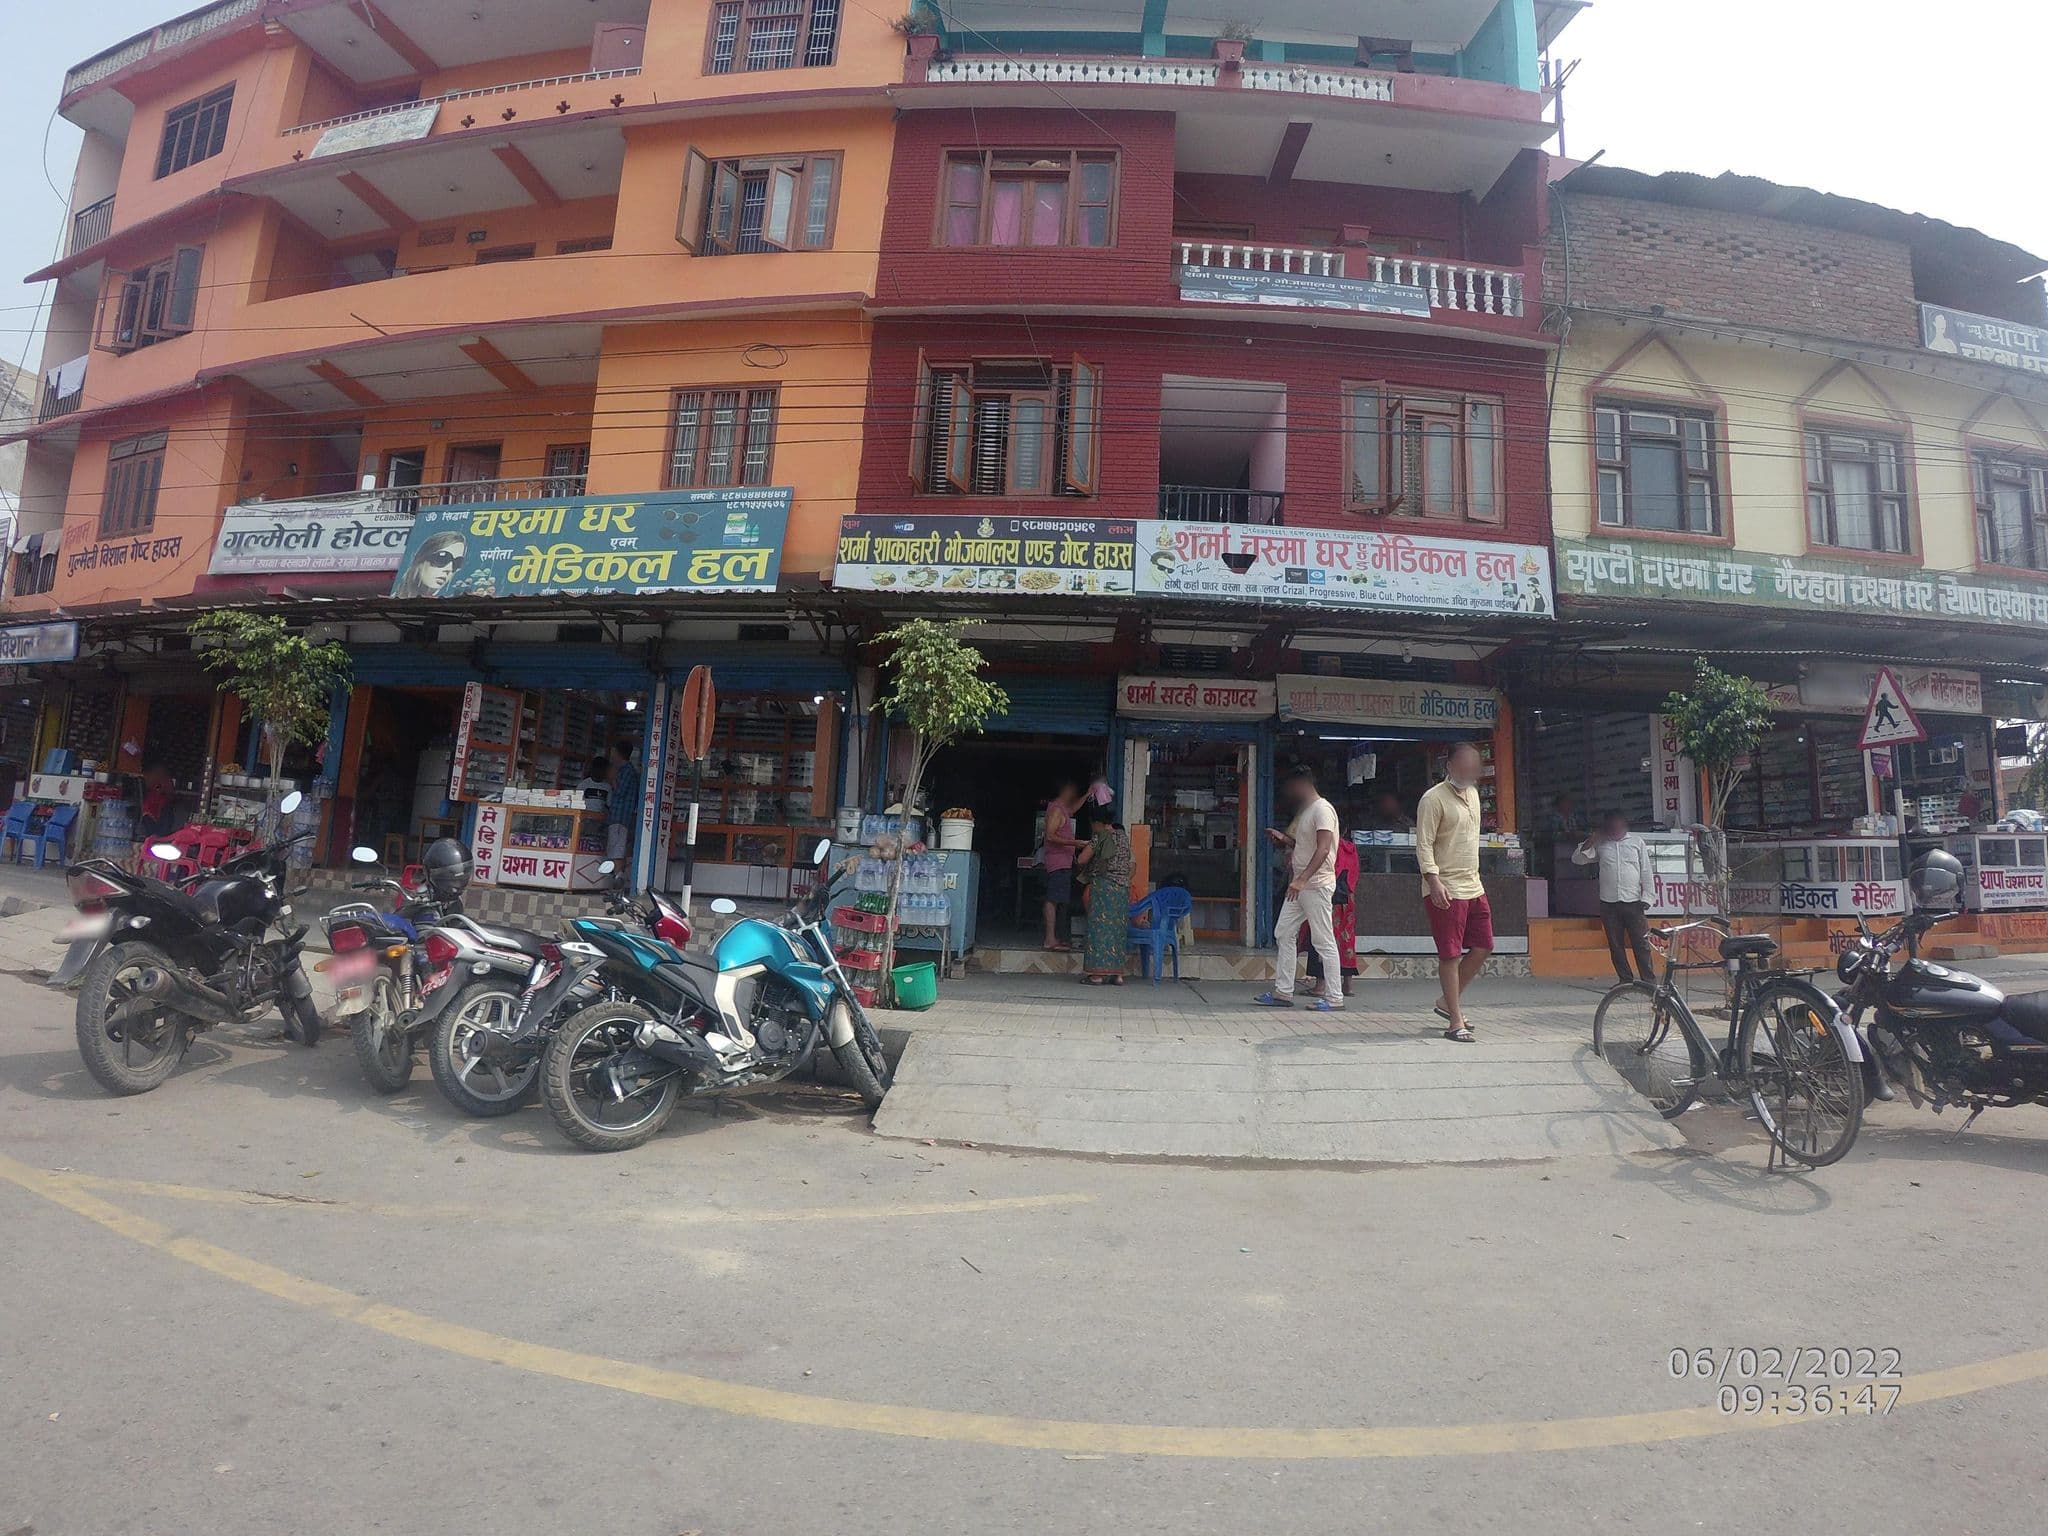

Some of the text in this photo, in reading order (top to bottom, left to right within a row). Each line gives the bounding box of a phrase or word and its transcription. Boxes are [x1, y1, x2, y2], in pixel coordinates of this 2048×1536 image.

[579, 503, 645, 534] घर
[331, 521, 412, 549] होटल
[839, 530, 1134, 571] शर्मा शाकाहारी भोजनालय एण्ड गेष्ट हाउस
[99, 543, 130, 569] विशाल
[151, 536, 183, 563] हाउस
[507, 543, 677, 585] मेडिकल
[687, 547, 774, 584] हल
[1174, 526, 1232, 563] शर्मा
[1315, 539, 1353, 571] घर
[1372, 533, 1467, 578] मेडिकल
[1475, 551, 1517, 582] हल
[1309, 587, 1358, 601] Progressive,
[1359, 589, 1378, 600] Blue
[1378, 591, 1395, 602] Cut,
[1396, 592, 1450, 606] Photochromic
[1642, 555, 1710, 592] चश्मा
[1716, 562, 1756, 594] घर
[1904, 580, 1933, 612] घर
[1126, 680, 1258, 709] शर्मा सटही काउण्टर
[1420, 688, 1470, 718] मेडिकल
[476, 806, 570, 880] मेडिकल चश्मा घर
[1980, 870, 2005, 890] थापा
[2005, 875, 2027, 890] चश्मा
[2027, 874, 2044, 889] घर
